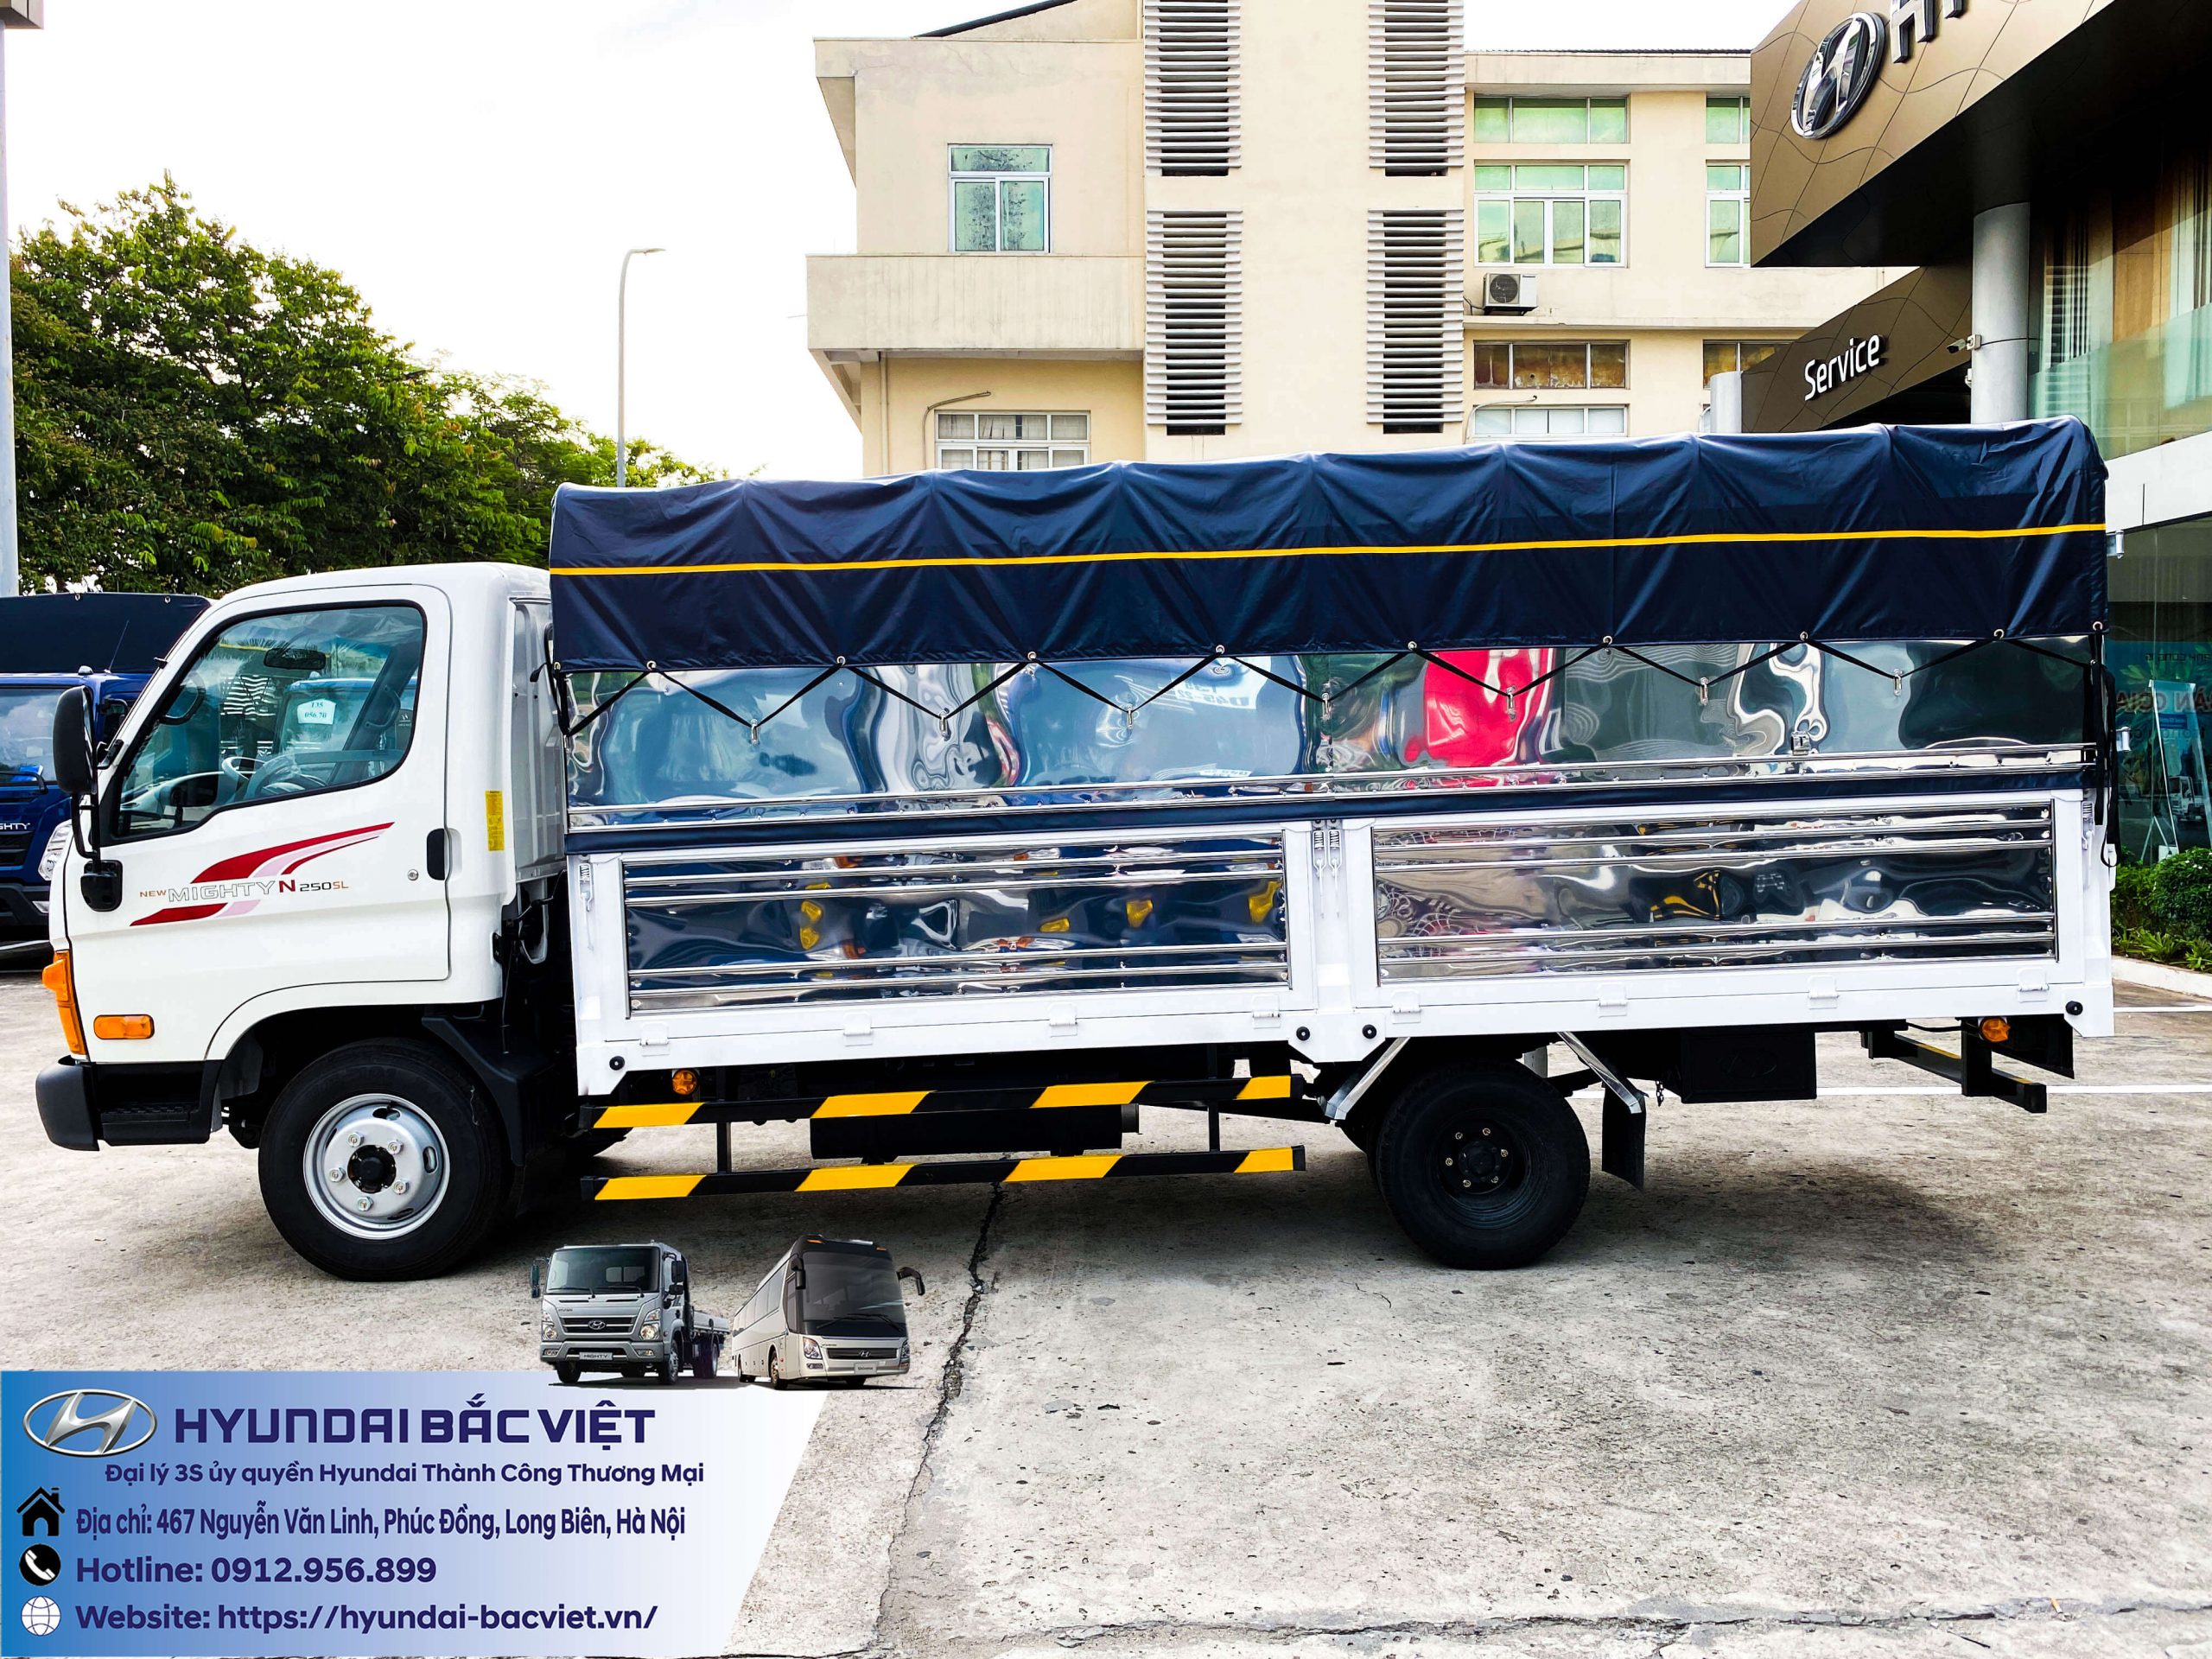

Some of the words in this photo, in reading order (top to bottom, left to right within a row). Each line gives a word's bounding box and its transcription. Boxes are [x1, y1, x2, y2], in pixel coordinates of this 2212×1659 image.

[1804, 334, 1880, 401] Service
[139, 889, 168, 898] NEW
[168, 880, 276, 902] MIGHTY
